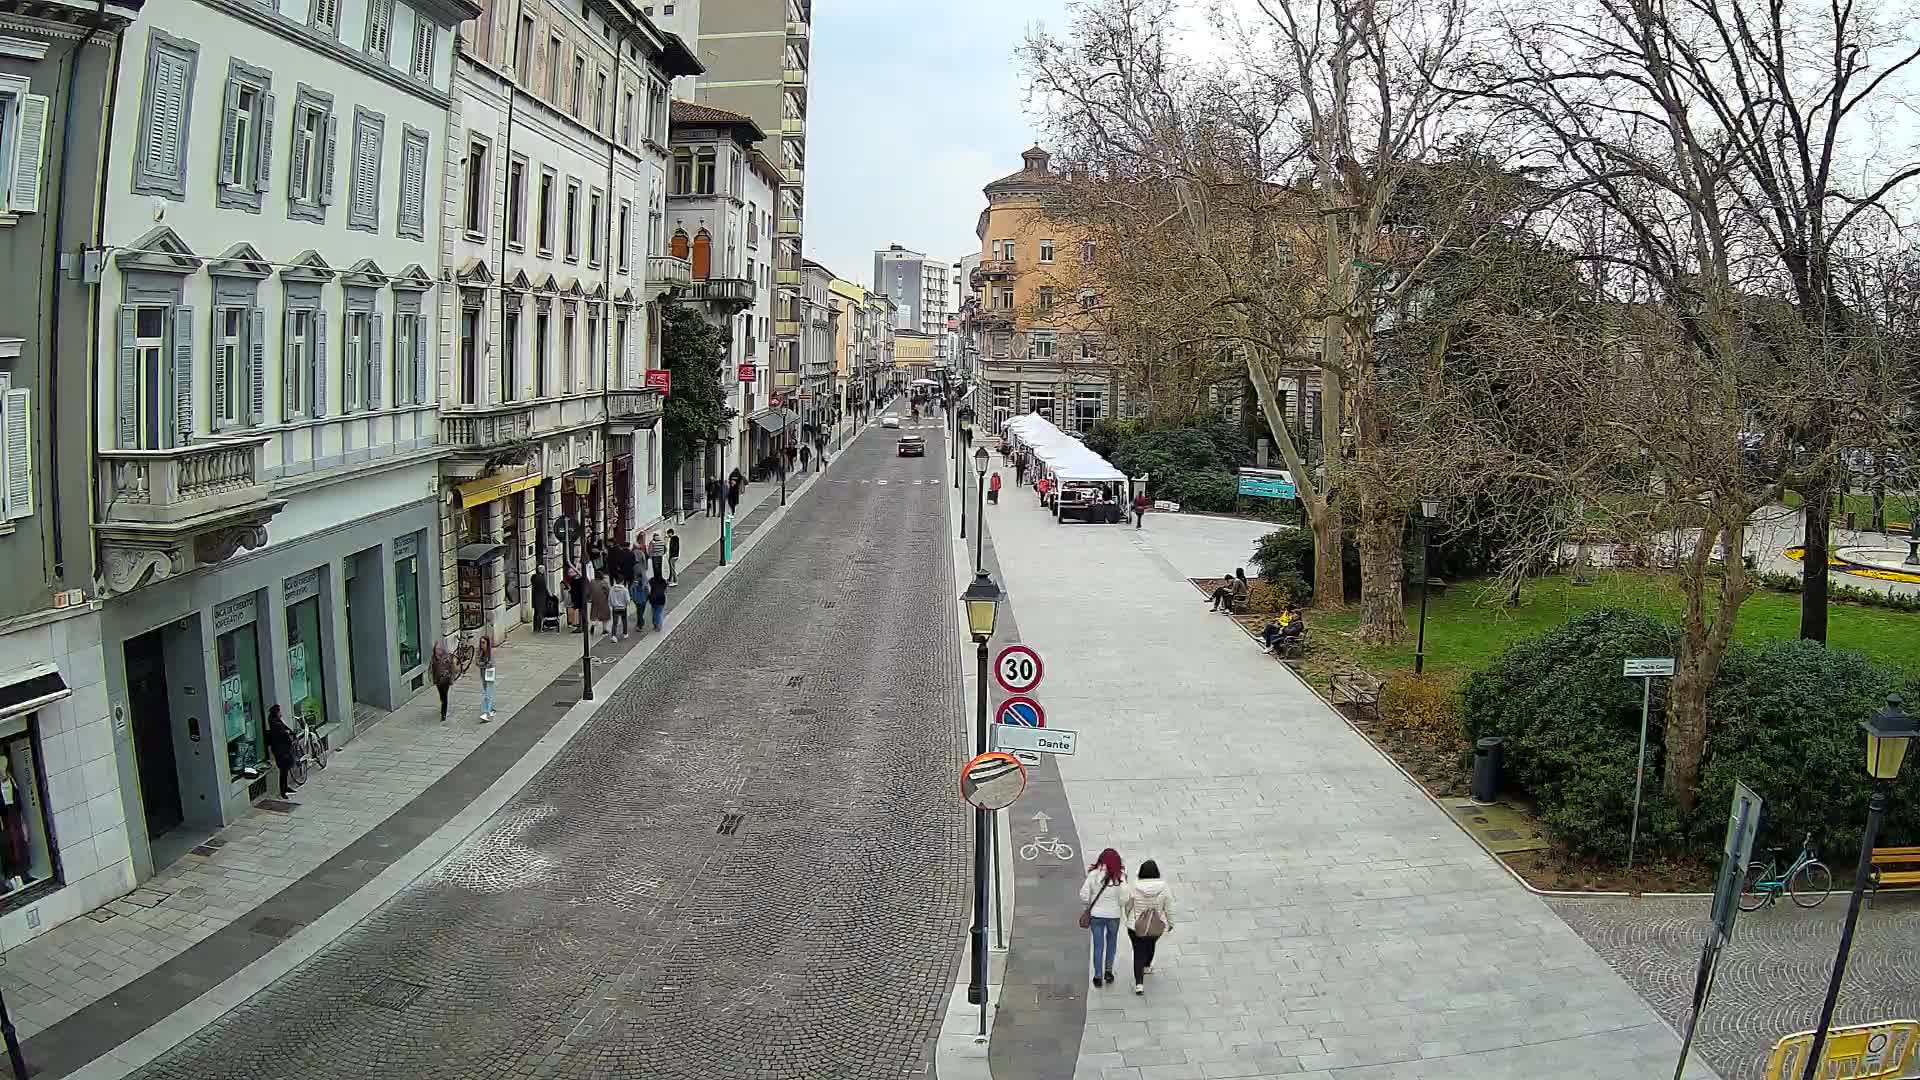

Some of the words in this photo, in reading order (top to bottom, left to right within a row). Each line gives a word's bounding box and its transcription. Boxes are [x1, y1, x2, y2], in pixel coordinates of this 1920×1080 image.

[1005, 658, 1033, 680] 30
[222, 678, 240, 701] 130
[1038, 738, 1070, 750] Dante
